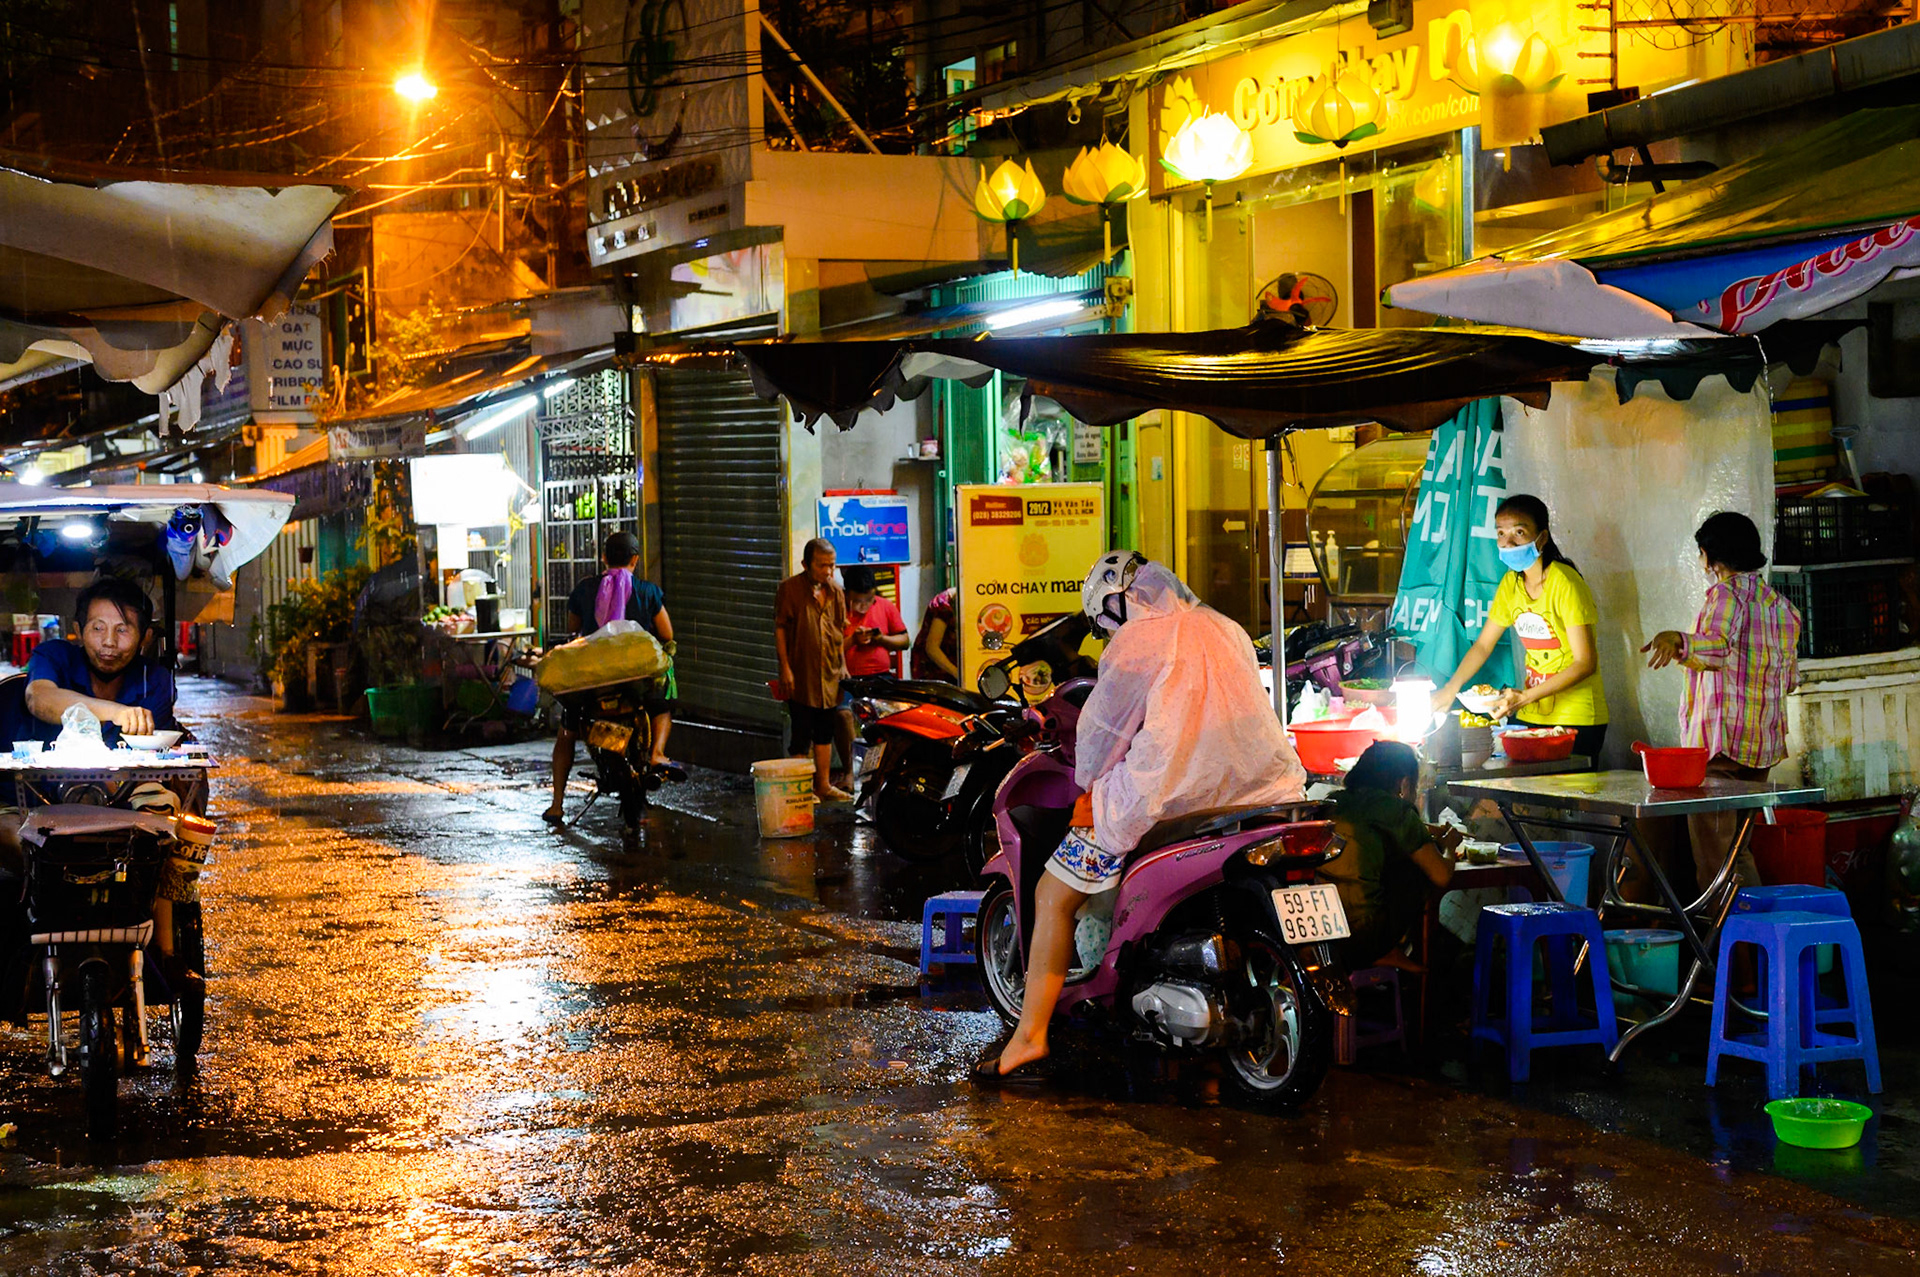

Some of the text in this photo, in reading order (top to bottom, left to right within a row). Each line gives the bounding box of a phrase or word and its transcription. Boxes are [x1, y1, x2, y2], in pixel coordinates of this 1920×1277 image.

[282, 340, 313, 354] MỰC
[272, 358, 303, 370] CAO
[821, 519, 908, 537] mobifone
[976, 580, 1007, 595] CƠM
[1010, 581, 1047, 594] CHAY
[1283, 889, 1331, 915] 59-F1
[1284, 912, 1343, 940] 963.64
